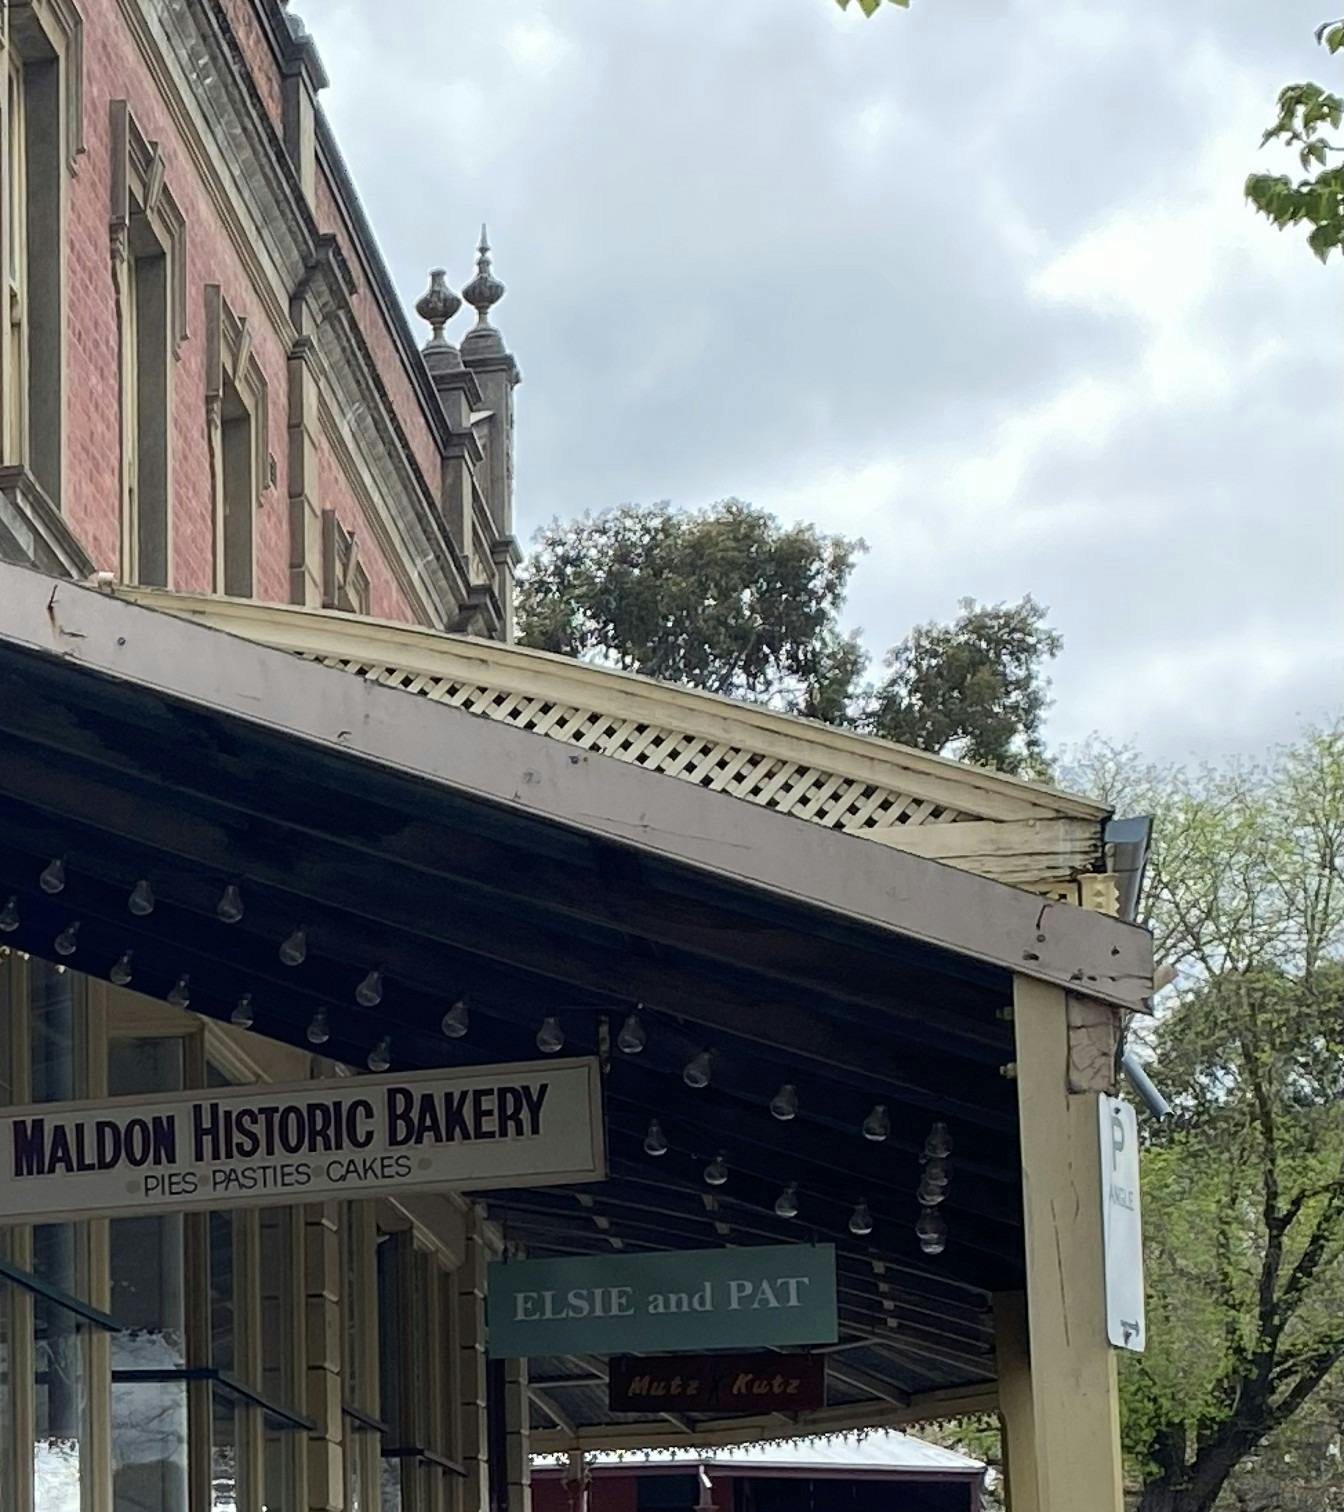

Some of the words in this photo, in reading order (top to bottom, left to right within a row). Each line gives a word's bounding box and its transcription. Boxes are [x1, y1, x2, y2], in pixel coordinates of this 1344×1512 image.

[12, 1112, 176, 1178] MALDON
[192, 1097, 375, 1163] HISTORIC
[386, 1082, 551, 1148] BAKERY
[143, 1171, 199, 1198] PIES
[211, 1162, 312, 1193] PASTIES
[325, 1154, 413, 1185] CAKES
[512, 1286, 635, 1322] ELSIE
[647, 1281, 715, 1315] and
[727, 1276, 810, 1311] PAT
[627, 1374, 700, 1397] Mutz
[731, 1371, 801, 1396] Kutz
